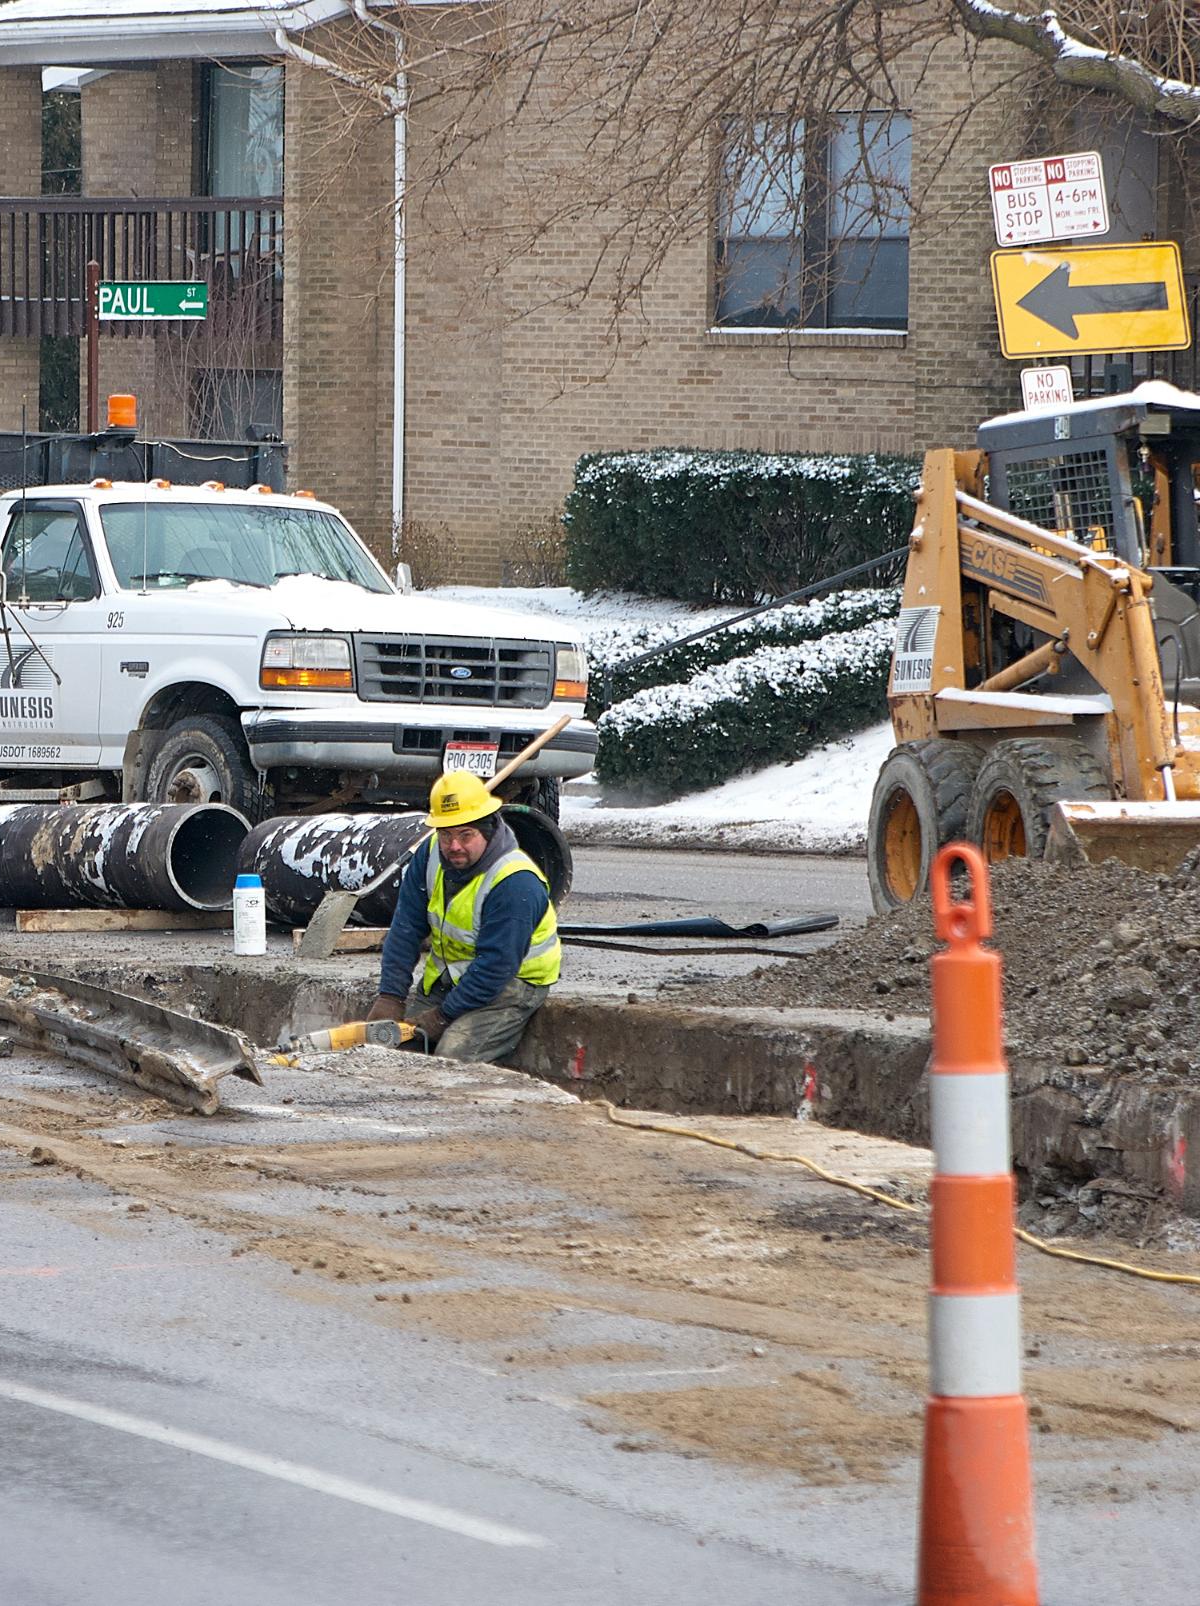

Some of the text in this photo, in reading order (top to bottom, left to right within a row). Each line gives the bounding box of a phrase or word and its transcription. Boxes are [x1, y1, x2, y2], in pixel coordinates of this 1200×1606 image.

[1014, 165, 1042, 176] STOPPING
[1046, 163, 1064, 180] NO
[1066, 158, 1095, 168] STOPPING
[993, 169, 1011, 187] NO
[1016, 175, 1042, 184] PARKING
[1068, 168, 1095, 177] PARKING
[1007, 191, 1037, 209] BUS
[1006, 209, 1043, 228] STOP
[99, 287, 197, 314] PAUL ST
[1036, 373, 1054, 389] NO
[1028, 388, 1068, 406] PARKING
[971, 540, 1017, 581] CASE
[107, 611, 125, 629] 925
[894, 658, 932, 681] SUNESIS
[28, 746, 61, 759] 1689562
[468, 753, 494, 770] 2305
